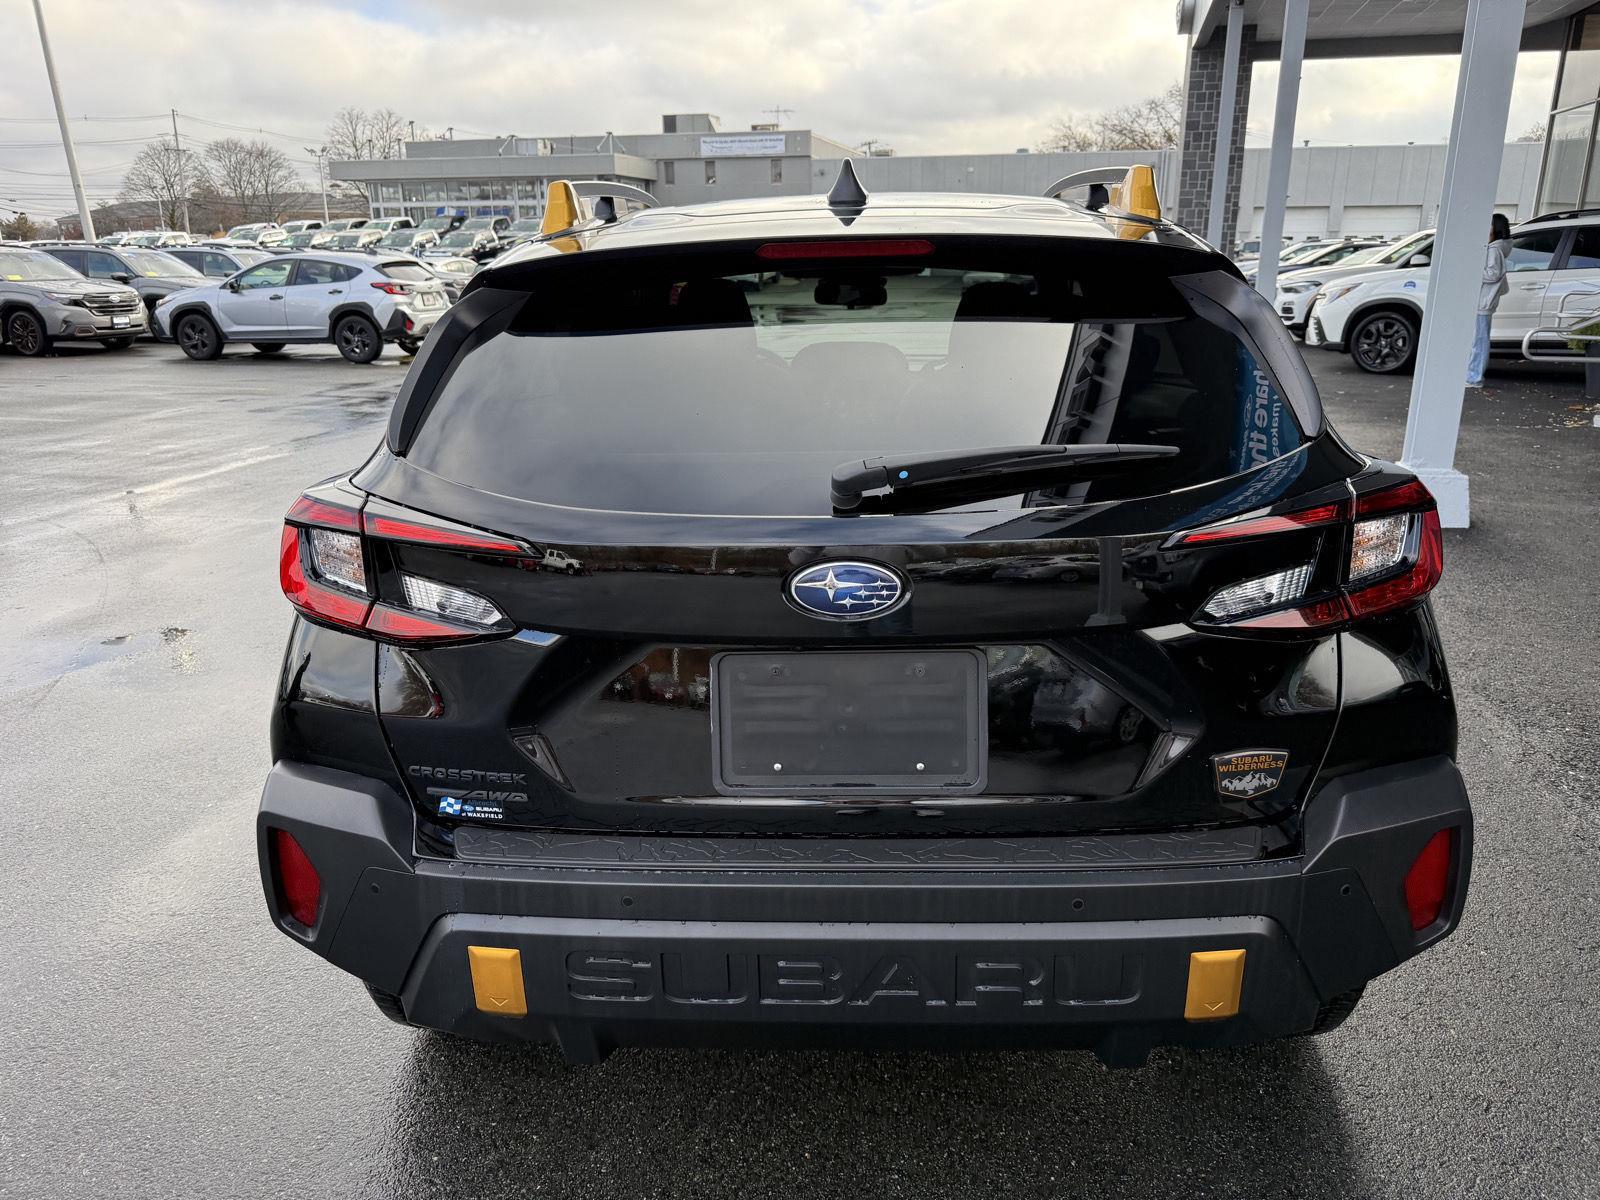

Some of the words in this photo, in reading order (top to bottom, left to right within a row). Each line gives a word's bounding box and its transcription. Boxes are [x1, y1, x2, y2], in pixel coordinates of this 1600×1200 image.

[1218, 760, 1284, 772] WILDERNESS
[1231, 754, 1273, 765] SUBARU
[408, 765, 528, 785] CROSSTREK
[462, 790, 528, 803] AWD
[565, 949, 1144, 1007] SUBARU
